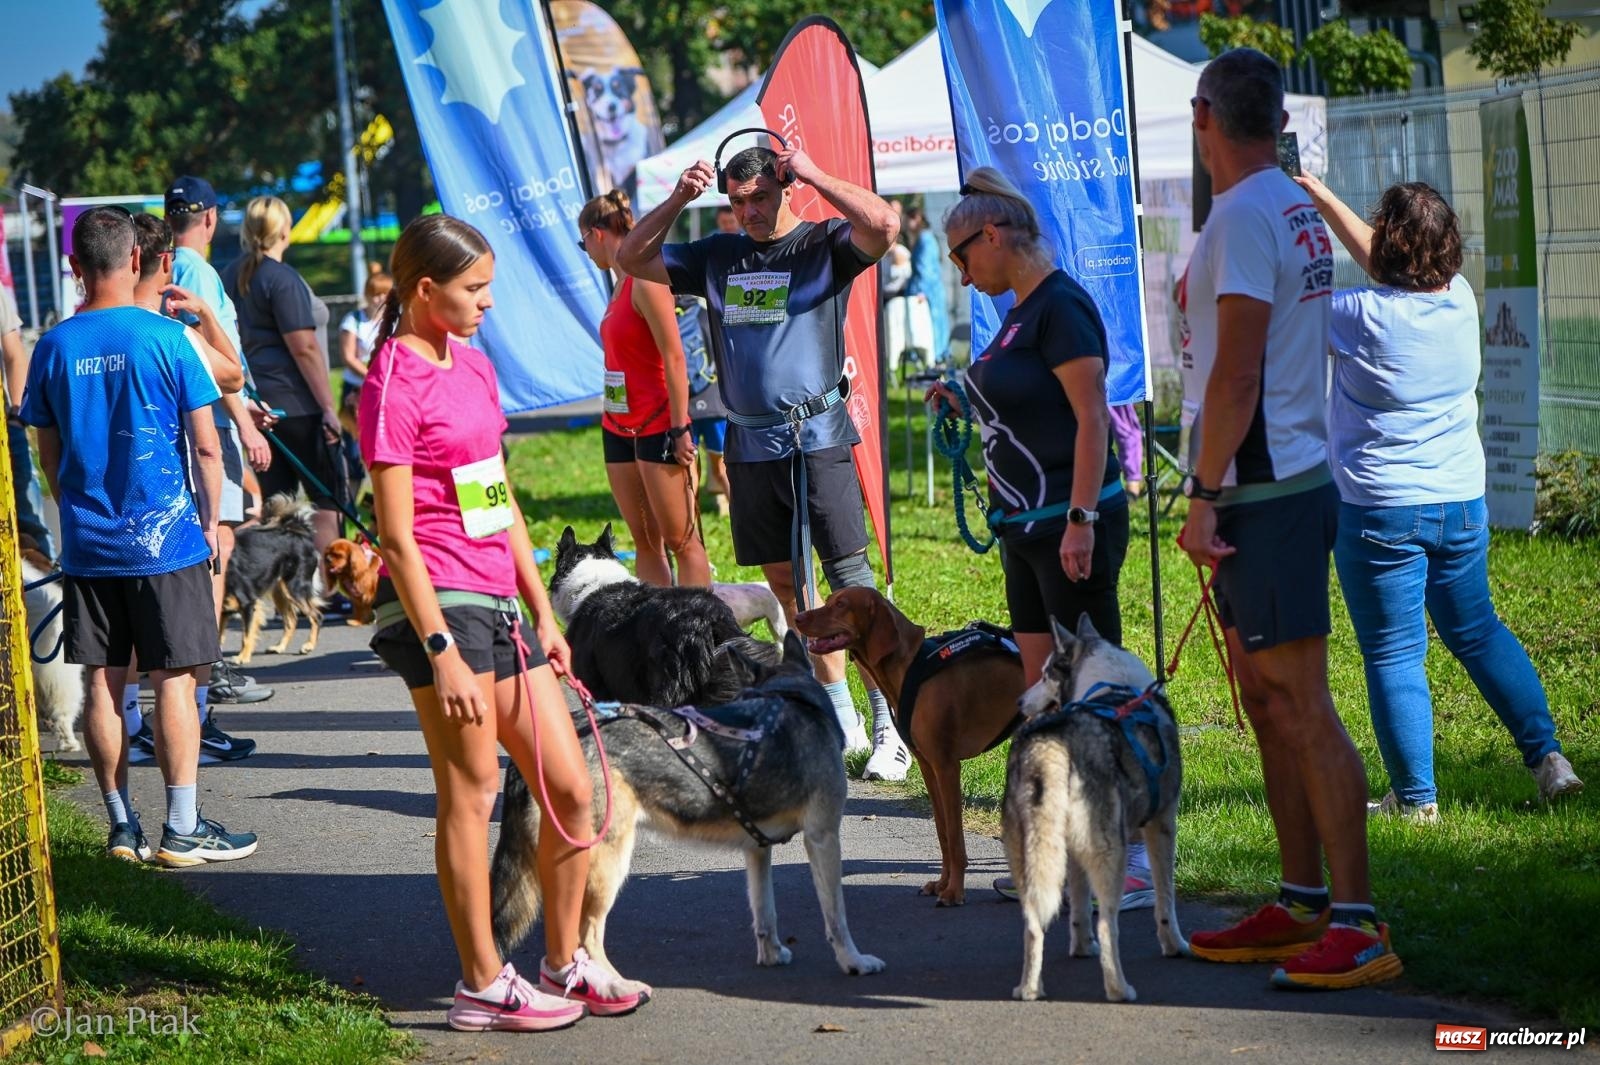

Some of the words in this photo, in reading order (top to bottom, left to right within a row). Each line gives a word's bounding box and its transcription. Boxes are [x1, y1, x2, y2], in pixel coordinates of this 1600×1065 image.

[873, 133, 955, 154] acibórz
[1495, 147, 1519, 178] ZOO
[1494, 178, 1518, 206] MAR
[743, 289, 767, 307] 92
[76, 353, 126, 376] KRZYCH
[485, 481, 508, 508] 99
